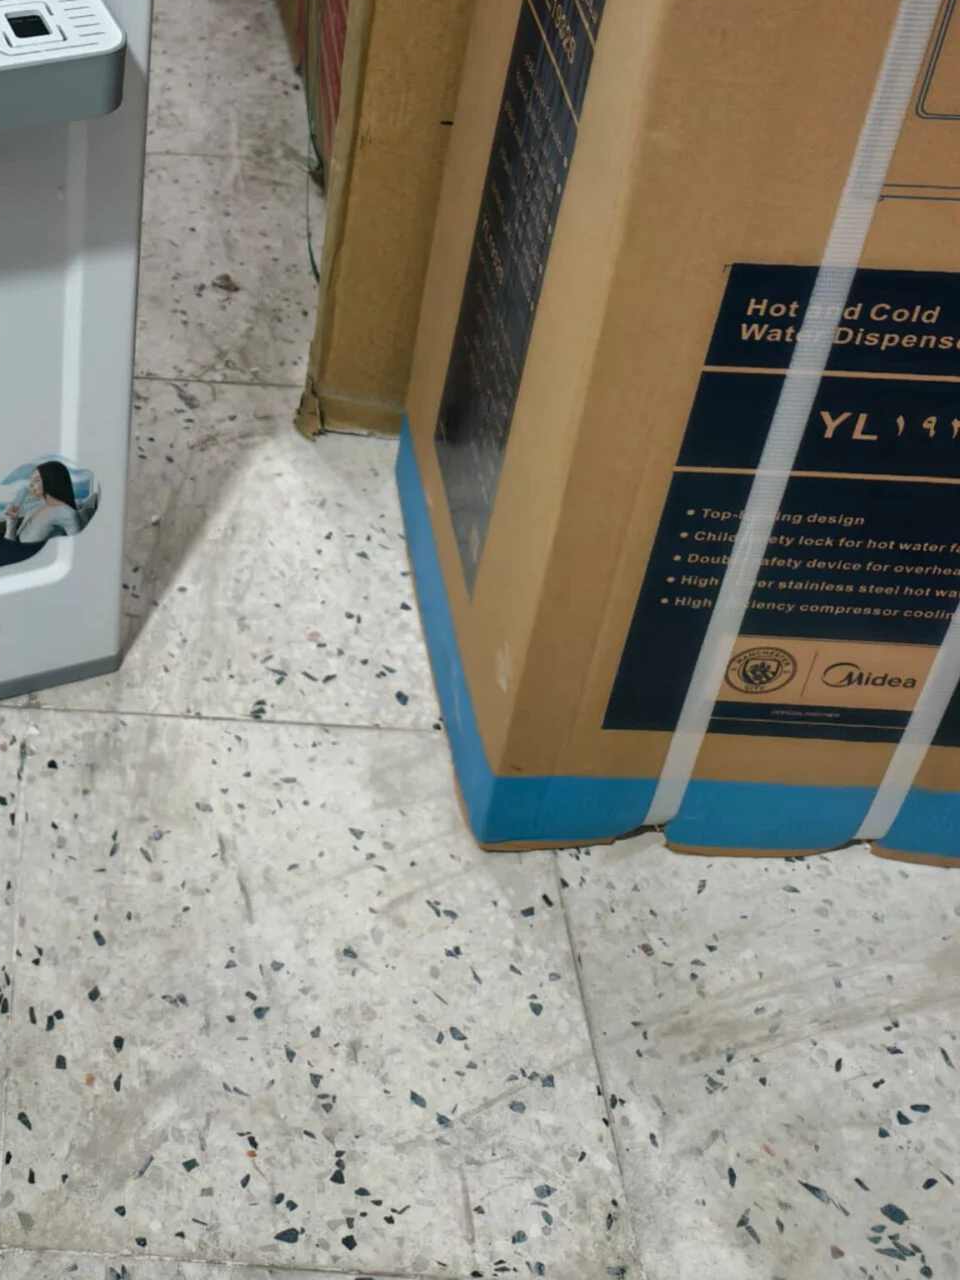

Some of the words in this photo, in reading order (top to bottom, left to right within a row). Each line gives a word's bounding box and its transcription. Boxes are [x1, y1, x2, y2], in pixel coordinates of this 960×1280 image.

[746, 298, 800, 318] Hot
[869, 303, 941, 324] Cold
[806, 512, 866, 527] design
[798, 534, 834, 548] lock
[838, 537, 864, 550] for
[866, 539, 895, 551] hot
[899, 541, 945, 553] water
[806, 558, 863, 572] device
[865, 561, 890, 572] for
[680, 575, 720, 589] High
[778, 579, 855, 593] stainless
[858, 584, 901, 596] steel
[904, 586, 931, 598] hot
[674, 596, 713, 610] High
[799, 602, 901, 618] compressor
[821, 661, 917, 689] Midea
